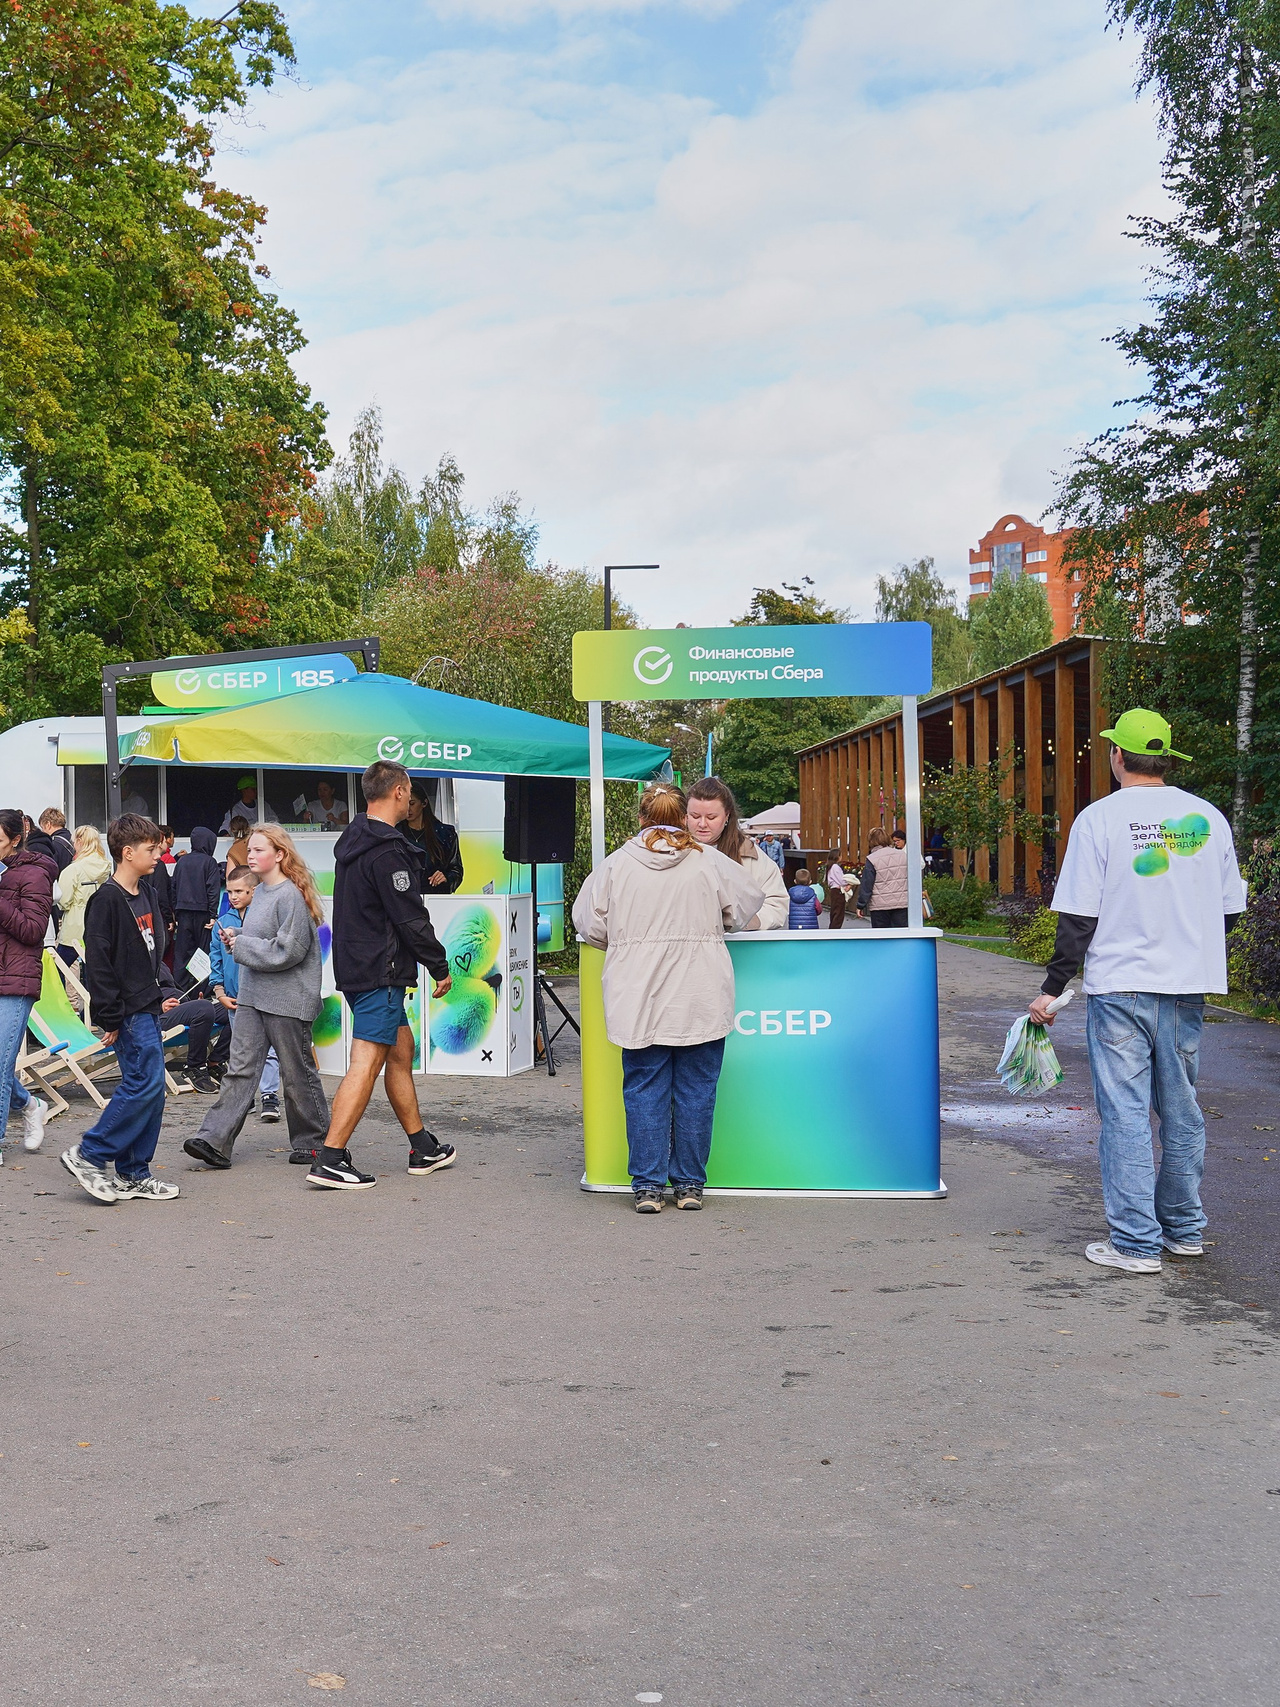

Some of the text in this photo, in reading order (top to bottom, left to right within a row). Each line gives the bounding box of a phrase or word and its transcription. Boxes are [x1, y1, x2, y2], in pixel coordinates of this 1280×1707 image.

[688, 646, 795, 660] Финансовые
[207, 669, 335, 689] СБЕР 185
[689, 664, 824, 685] продукты Сбера
[410, 741, 472, 761] СБЕР
[1129, 822, 1167, 831] Быть
[1131, 830, 1196, 841] зелёным
[1133, 841, 1202, 850] значит рядом
[734, 1010, 832, 1036] СБЕР
